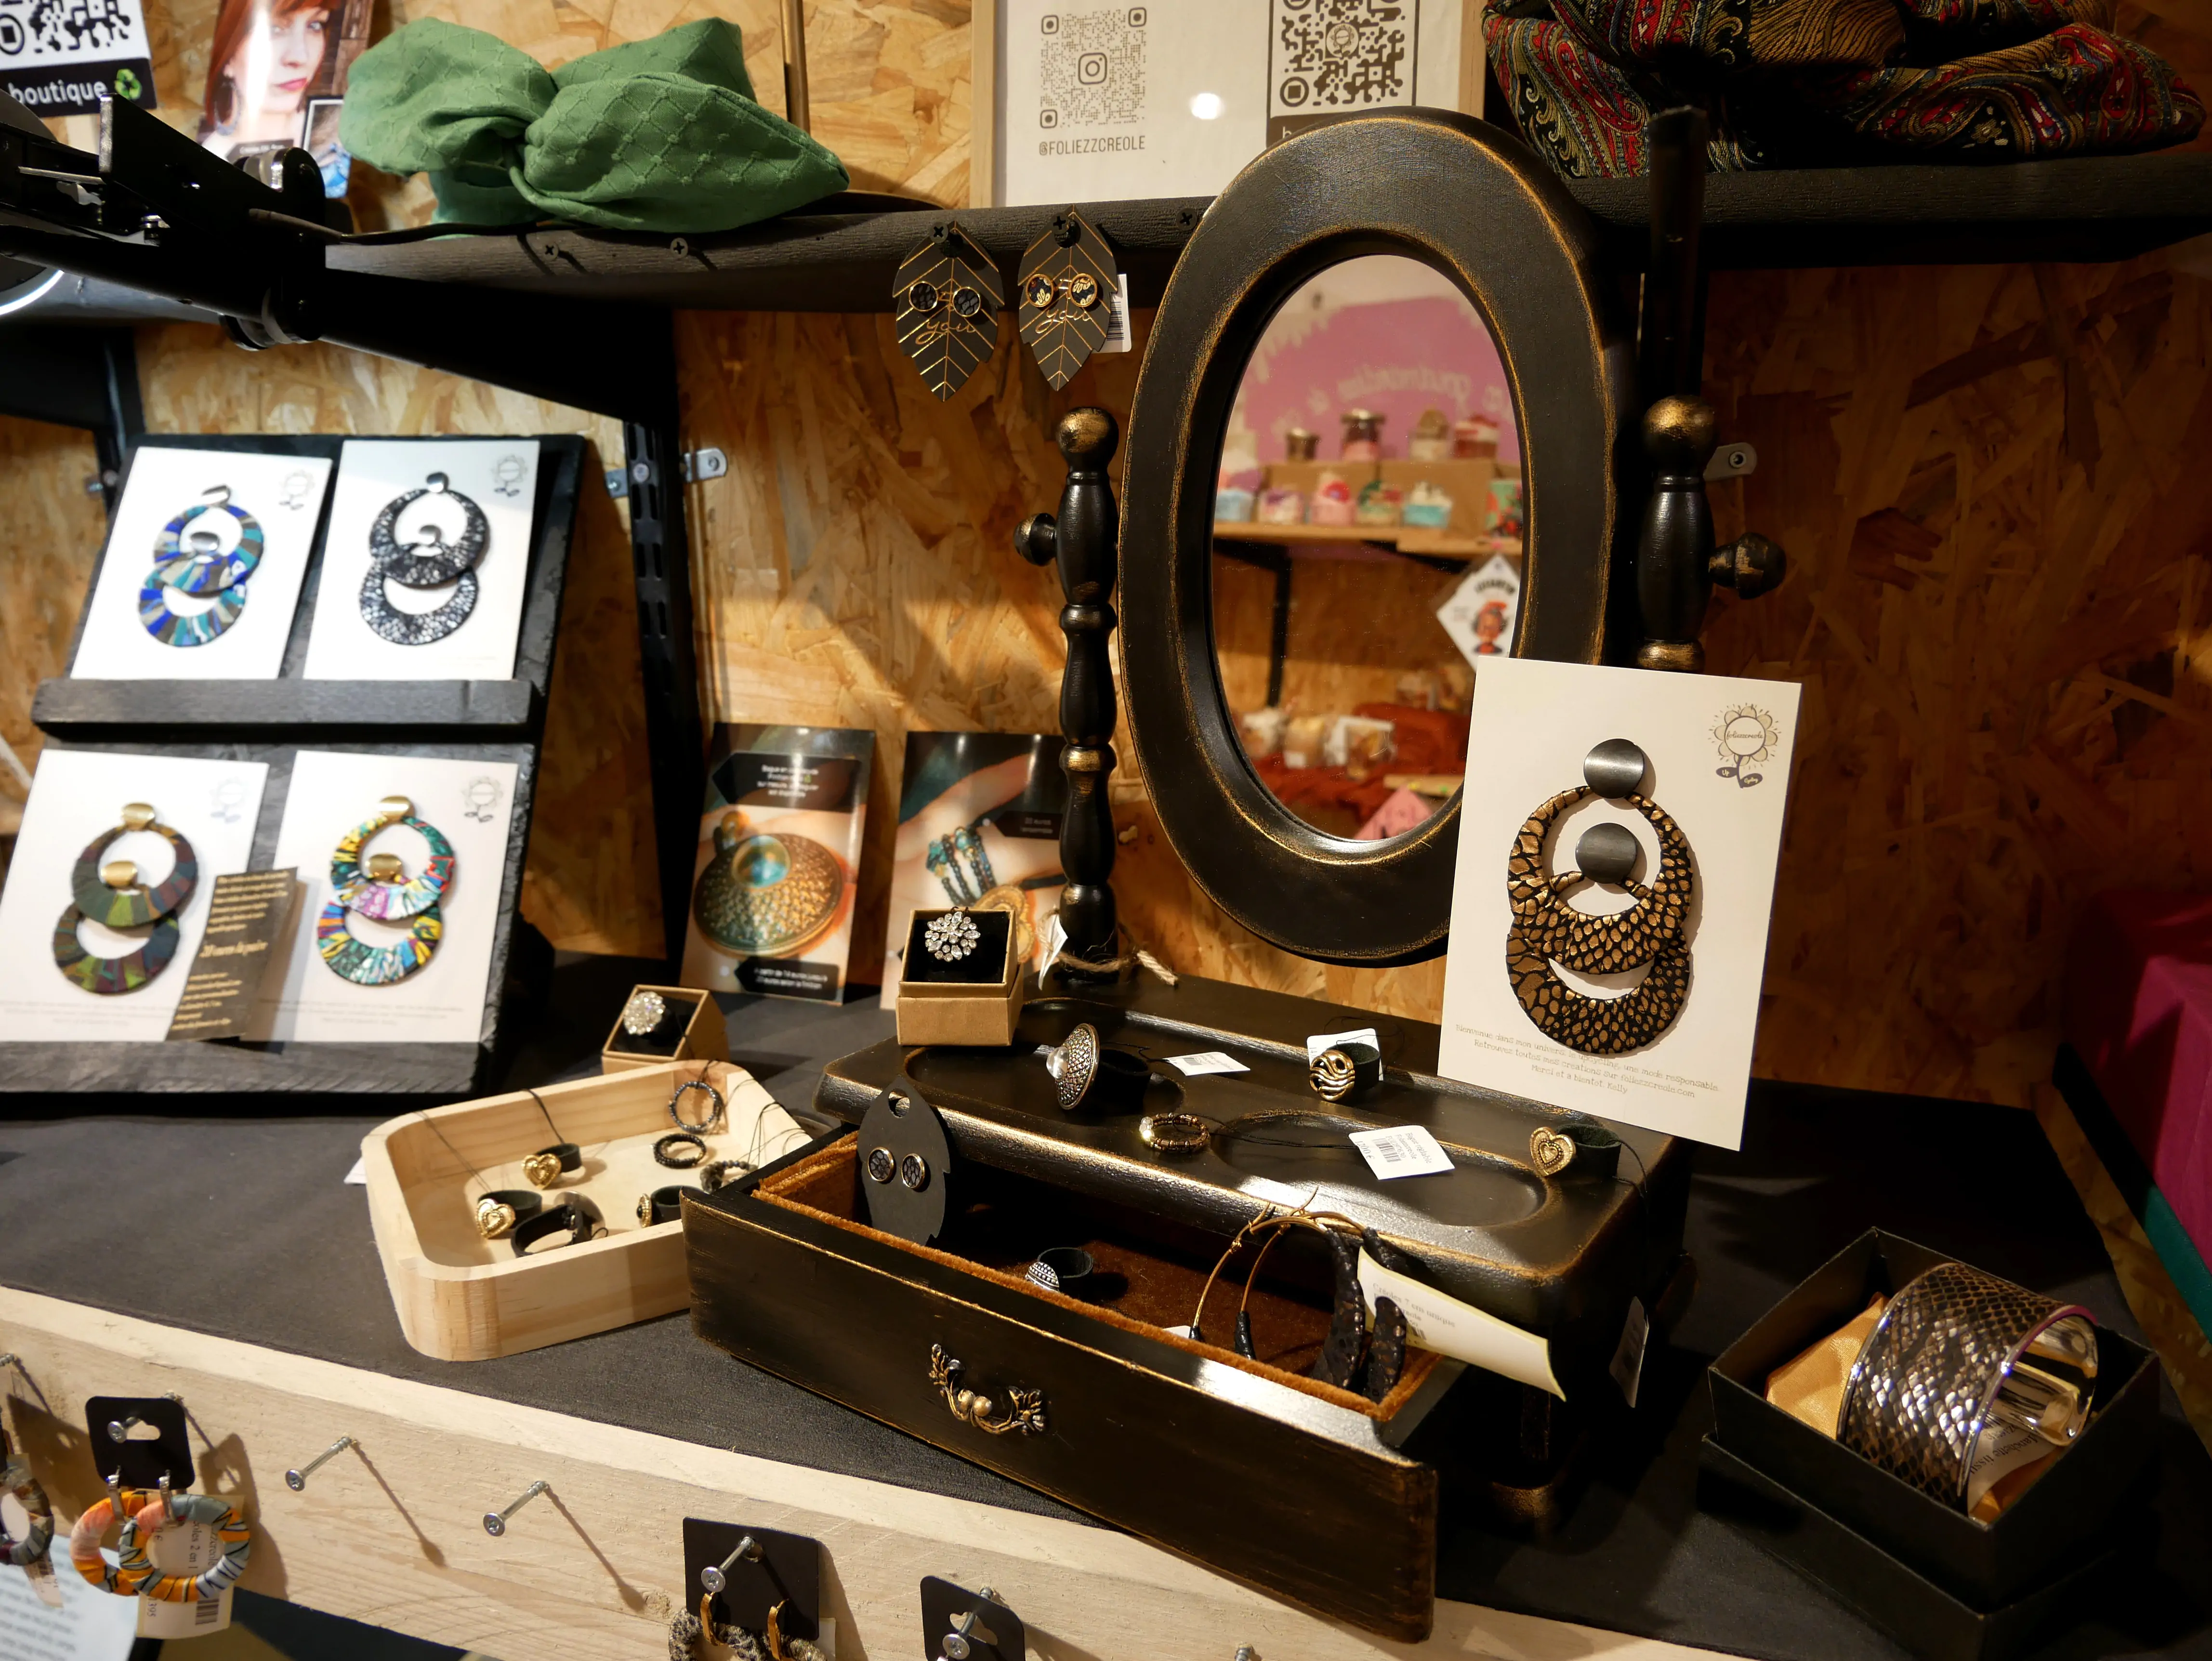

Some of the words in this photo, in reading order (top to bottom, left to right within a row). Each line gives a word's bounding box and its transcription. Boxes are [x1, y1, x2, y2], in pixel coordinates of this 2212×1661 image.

[8, 79, 107, 106] boutique
[1039, 135, 1146, 156] @FOLIEZZCREOLE
[1726, 730, 1764, 740] foliezzcreole
[1456, 1024, 1493, 1039] Bienvenue
[1495, 1033, 1514, 1043] dans
[1515, 1039, 1531, 1048] mon
[1624, 1064, 1638, 1073] une
[1642, 1068, 1663, 1079] mode
[1474, 1039, 1513, 1054] Retrouvez
[1515, 1048, 1541, 1061] toutes
[1543, 1056, 1559, 1065] mes
[1603, 1070, 1618, 1079] sur
[1621, 1074, 1695, 1098] foliezzcreole.com
[1531, 1064, 1554, 1075] Merci
[1556, 1070, 1564, 1078] et
[1607, 1082, 1628, 1094] Kelly
